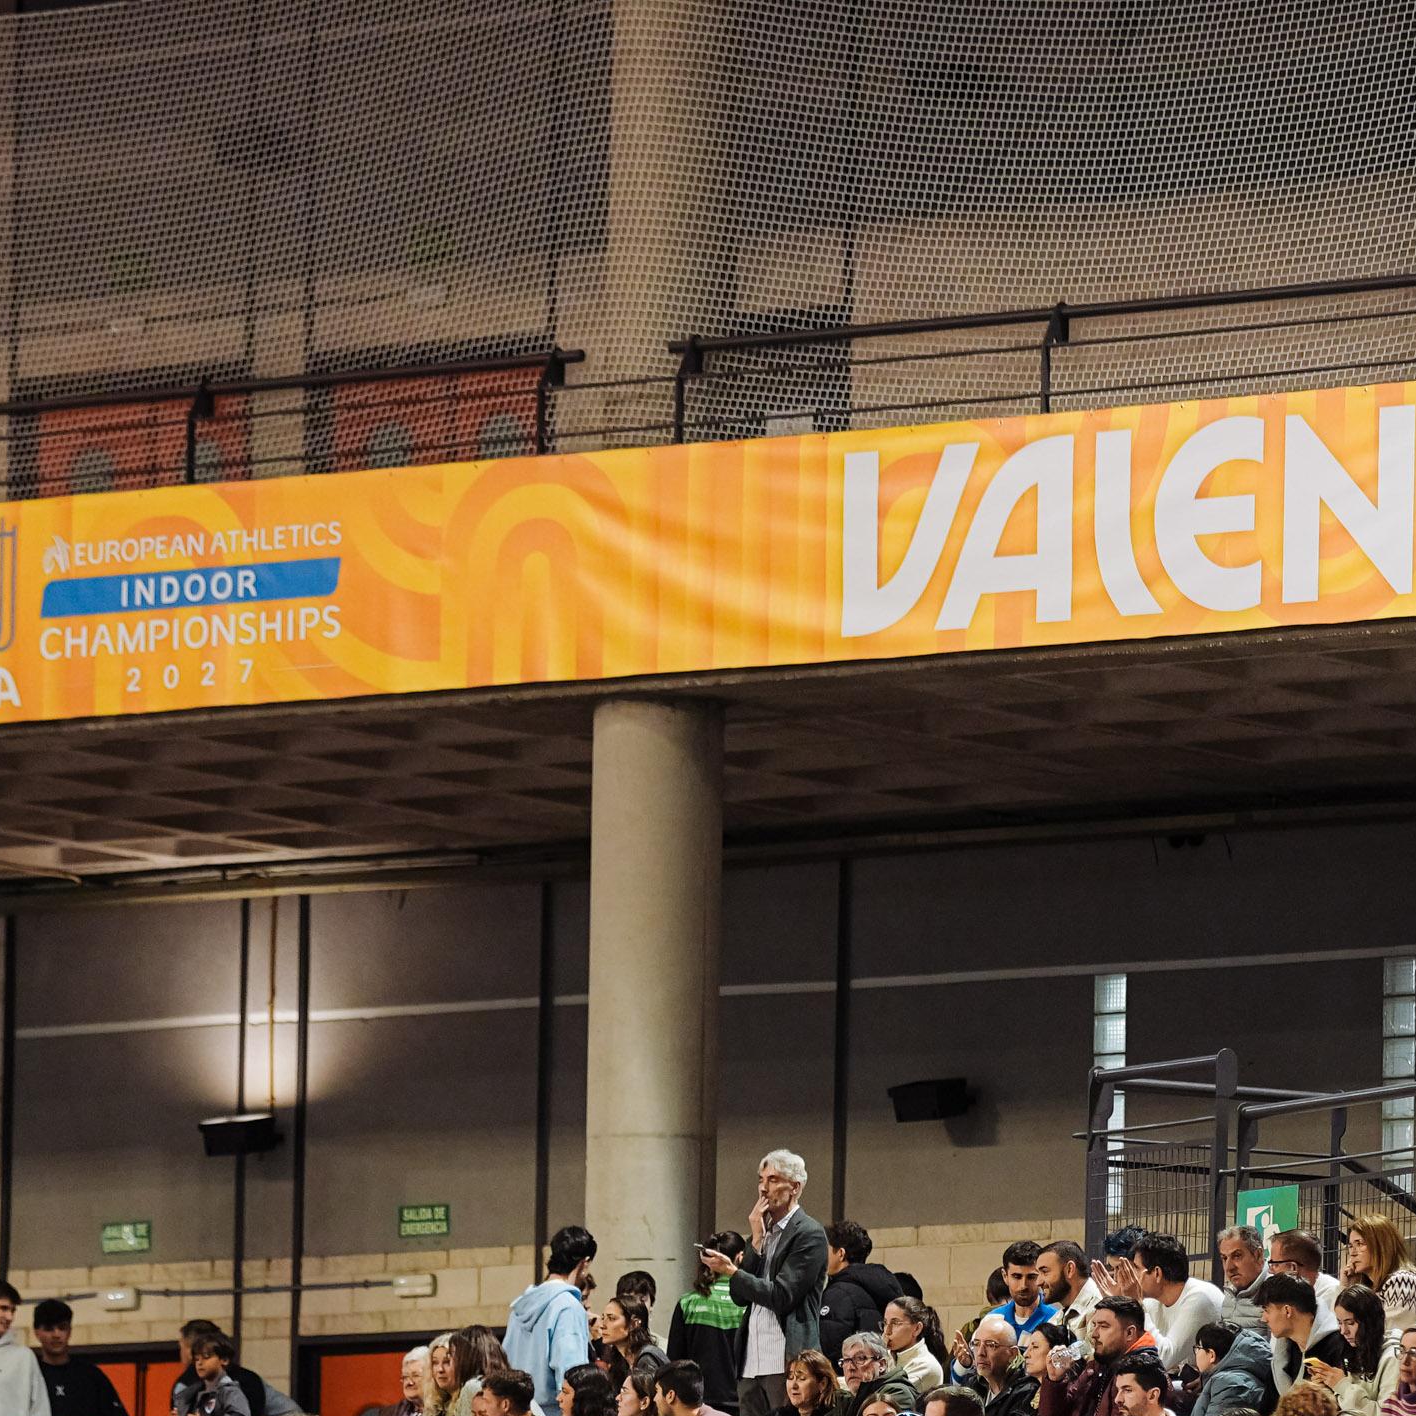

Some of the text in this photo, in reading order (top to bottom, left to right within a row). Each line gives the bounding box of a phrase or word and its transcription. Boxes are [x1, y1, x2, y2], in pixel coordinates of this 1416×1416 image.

[74, 521, 342, 566] EUROPEAN ATHLETICS
[120, 570, 258, 608] INDOOR
[39, 605, 342, 661] CHAMPIONSHIPS
[126, 659, 254, 693] 2027
